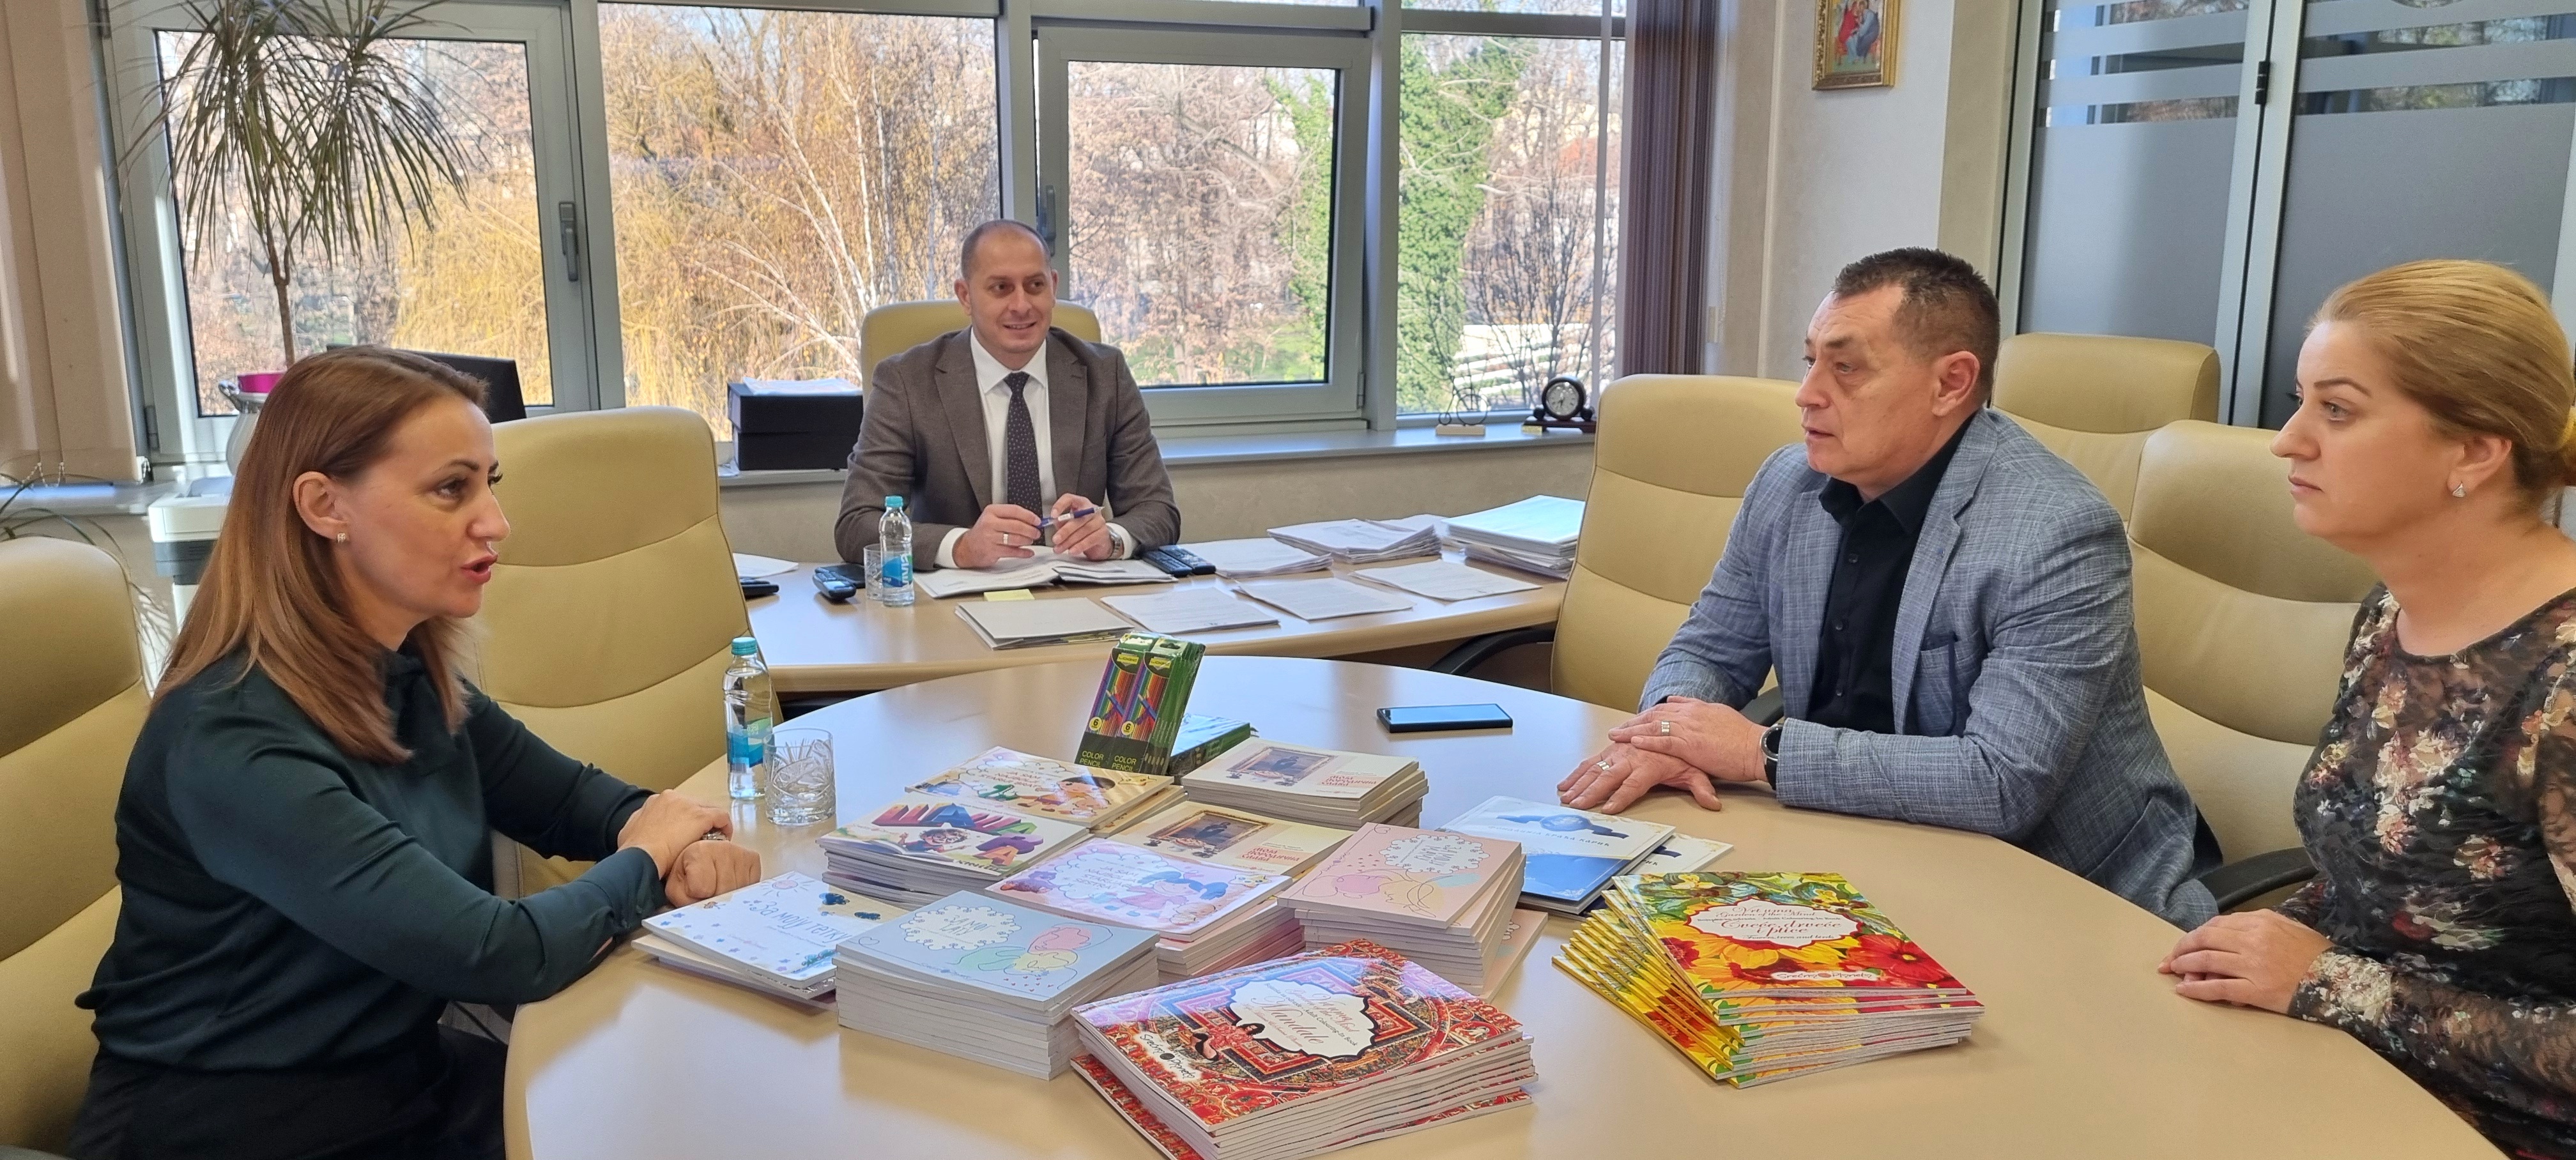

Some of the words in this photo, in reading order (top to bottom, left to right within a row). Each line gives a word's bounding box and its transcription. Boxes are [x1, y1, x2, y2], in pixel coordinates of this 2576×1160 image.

[1082, 751, 1105, 760] COLOR
[1114, 755, 1137, 765] COLOR
[1080, 758, 1101, 768] PENCIL
[1112, 762, 1133, 772] PENCIL
[1765, 927, 1808, 937] ptice
[1250, 995, 1330, 1044] Mandale
